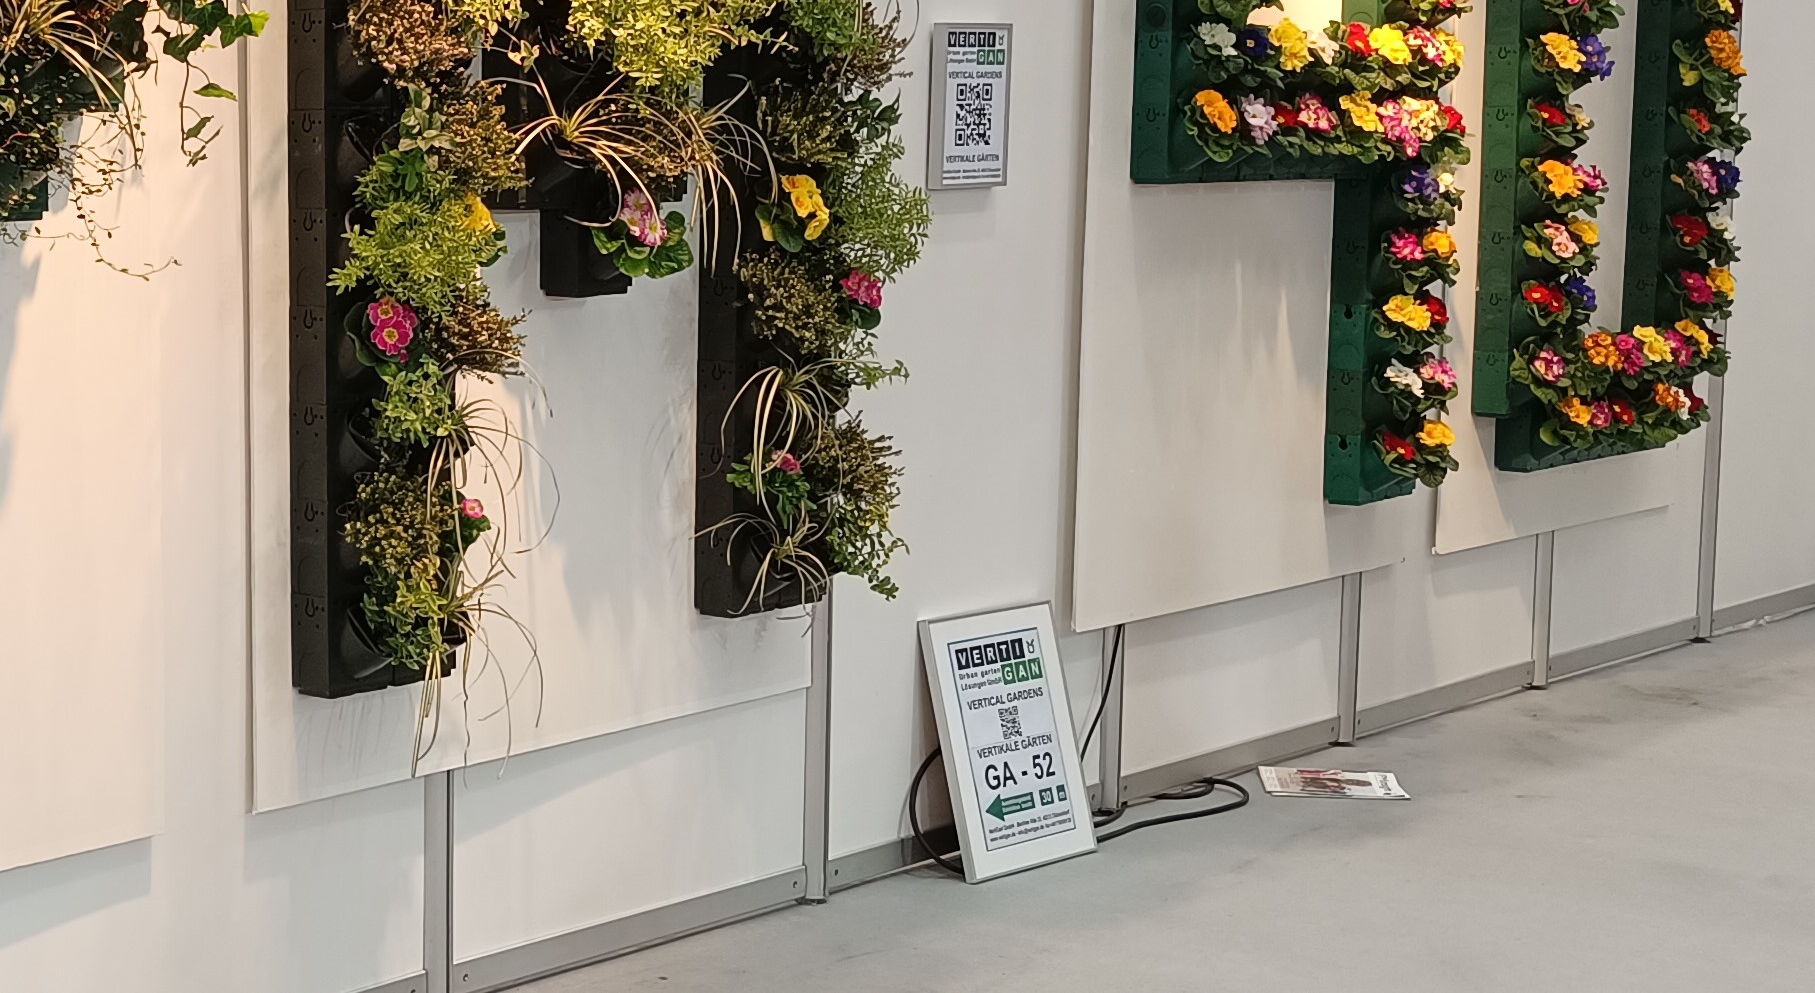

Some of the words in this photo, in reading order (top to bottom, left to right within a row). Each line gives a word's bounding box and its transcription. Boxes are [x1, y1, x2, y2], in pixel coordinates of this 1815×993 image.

[950, 34, 993, 45] VERTI
[978, 51, 1003, 62] GAN
[958, 642, 1020, 666] VERTI
[1004, 662, 1040, 680] GAN
[967, 695, 1005, 710] VERTICAL
[1007, 687, 1043, 702] GARDENS
[977, 741, 1020, 759] VERTIKALE
[1021, 734, 1052, 749] GÄRTEN
[985, 761, 1017, 790] GA
[1032, 752, 1056, 779] 52
[1041, 790, 1052, 803] 30
